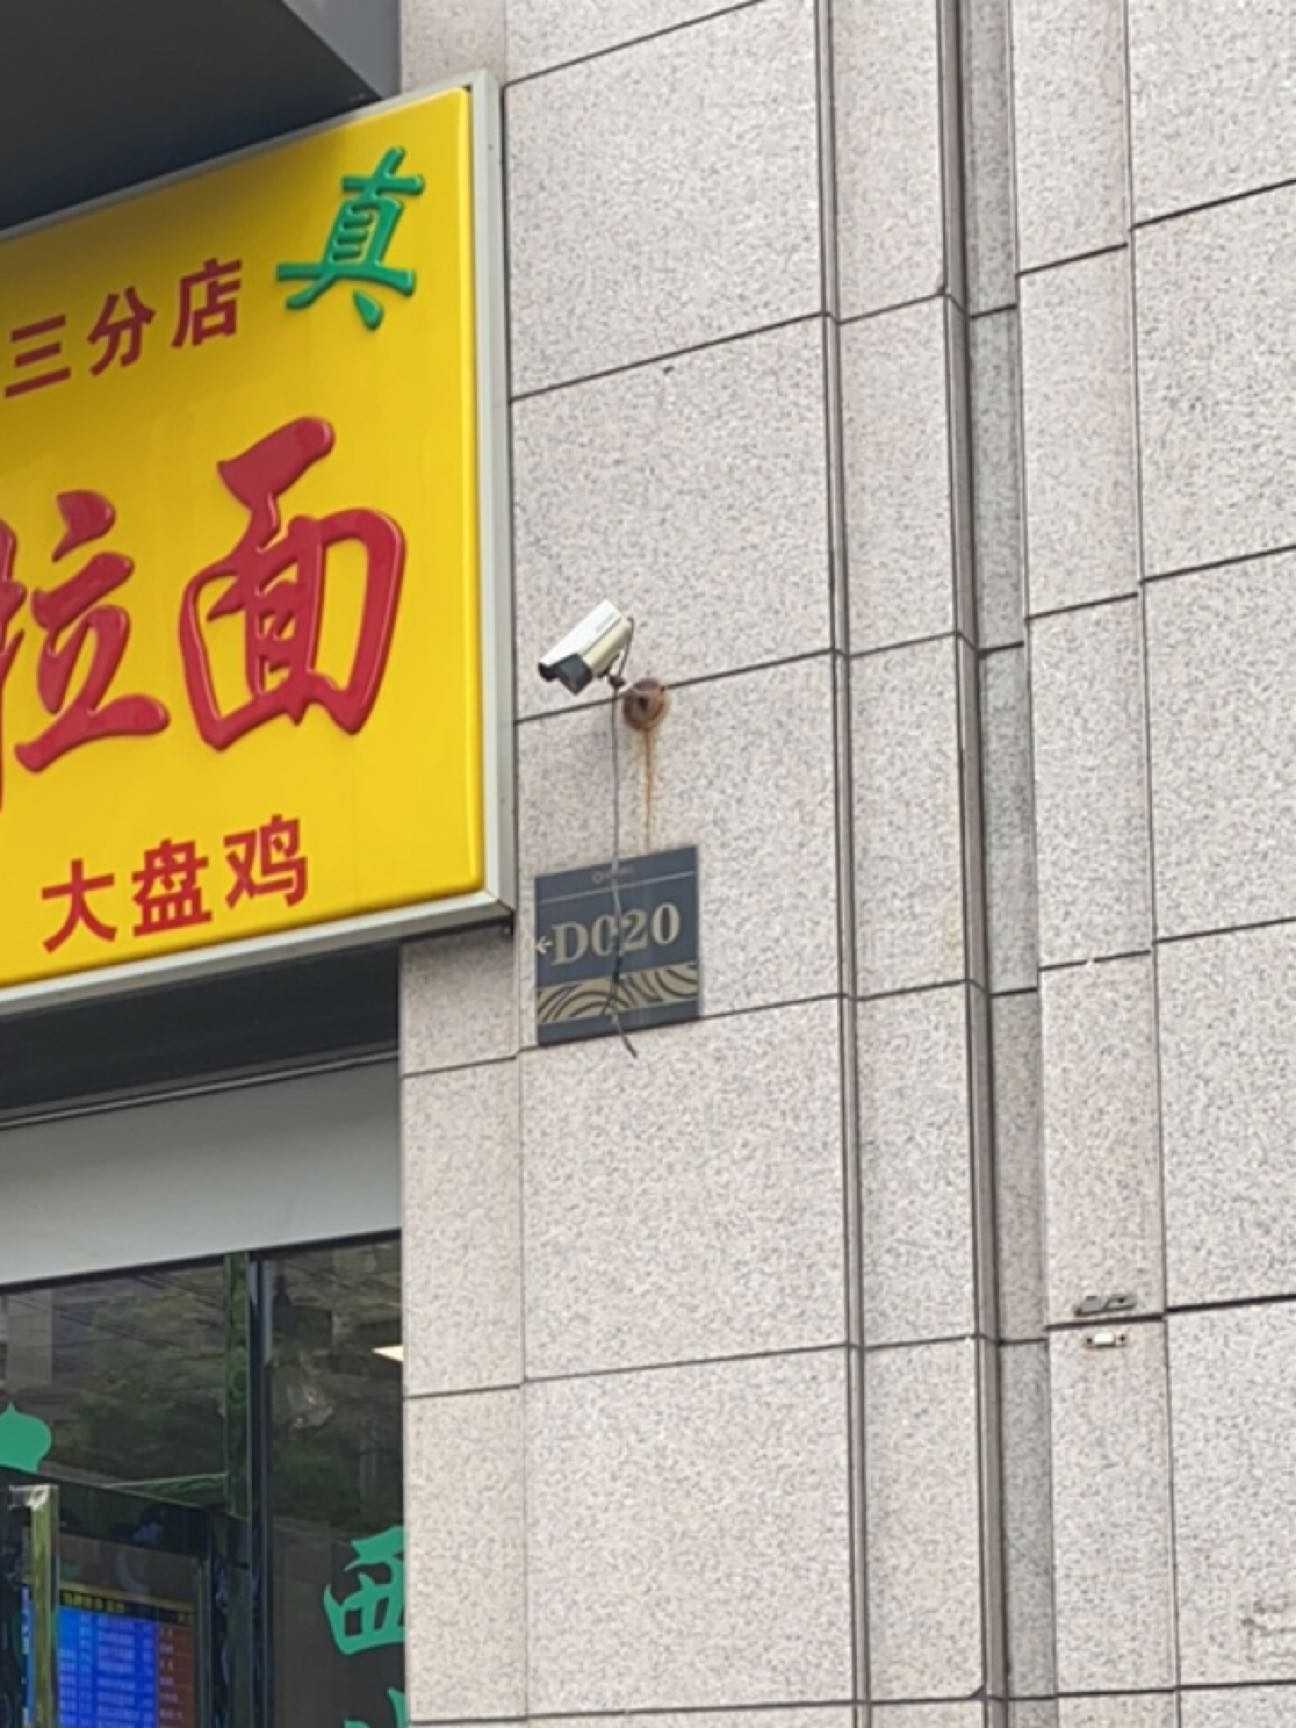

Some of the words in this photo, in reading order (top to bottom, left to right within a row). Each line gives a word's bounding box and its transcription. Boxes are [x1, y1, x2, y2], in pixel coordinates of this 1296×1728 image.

[275, 146, 425, 330] 真
[42, 813, 309, 953] 大盘鸡
[551, 902, 681, 966] D020
